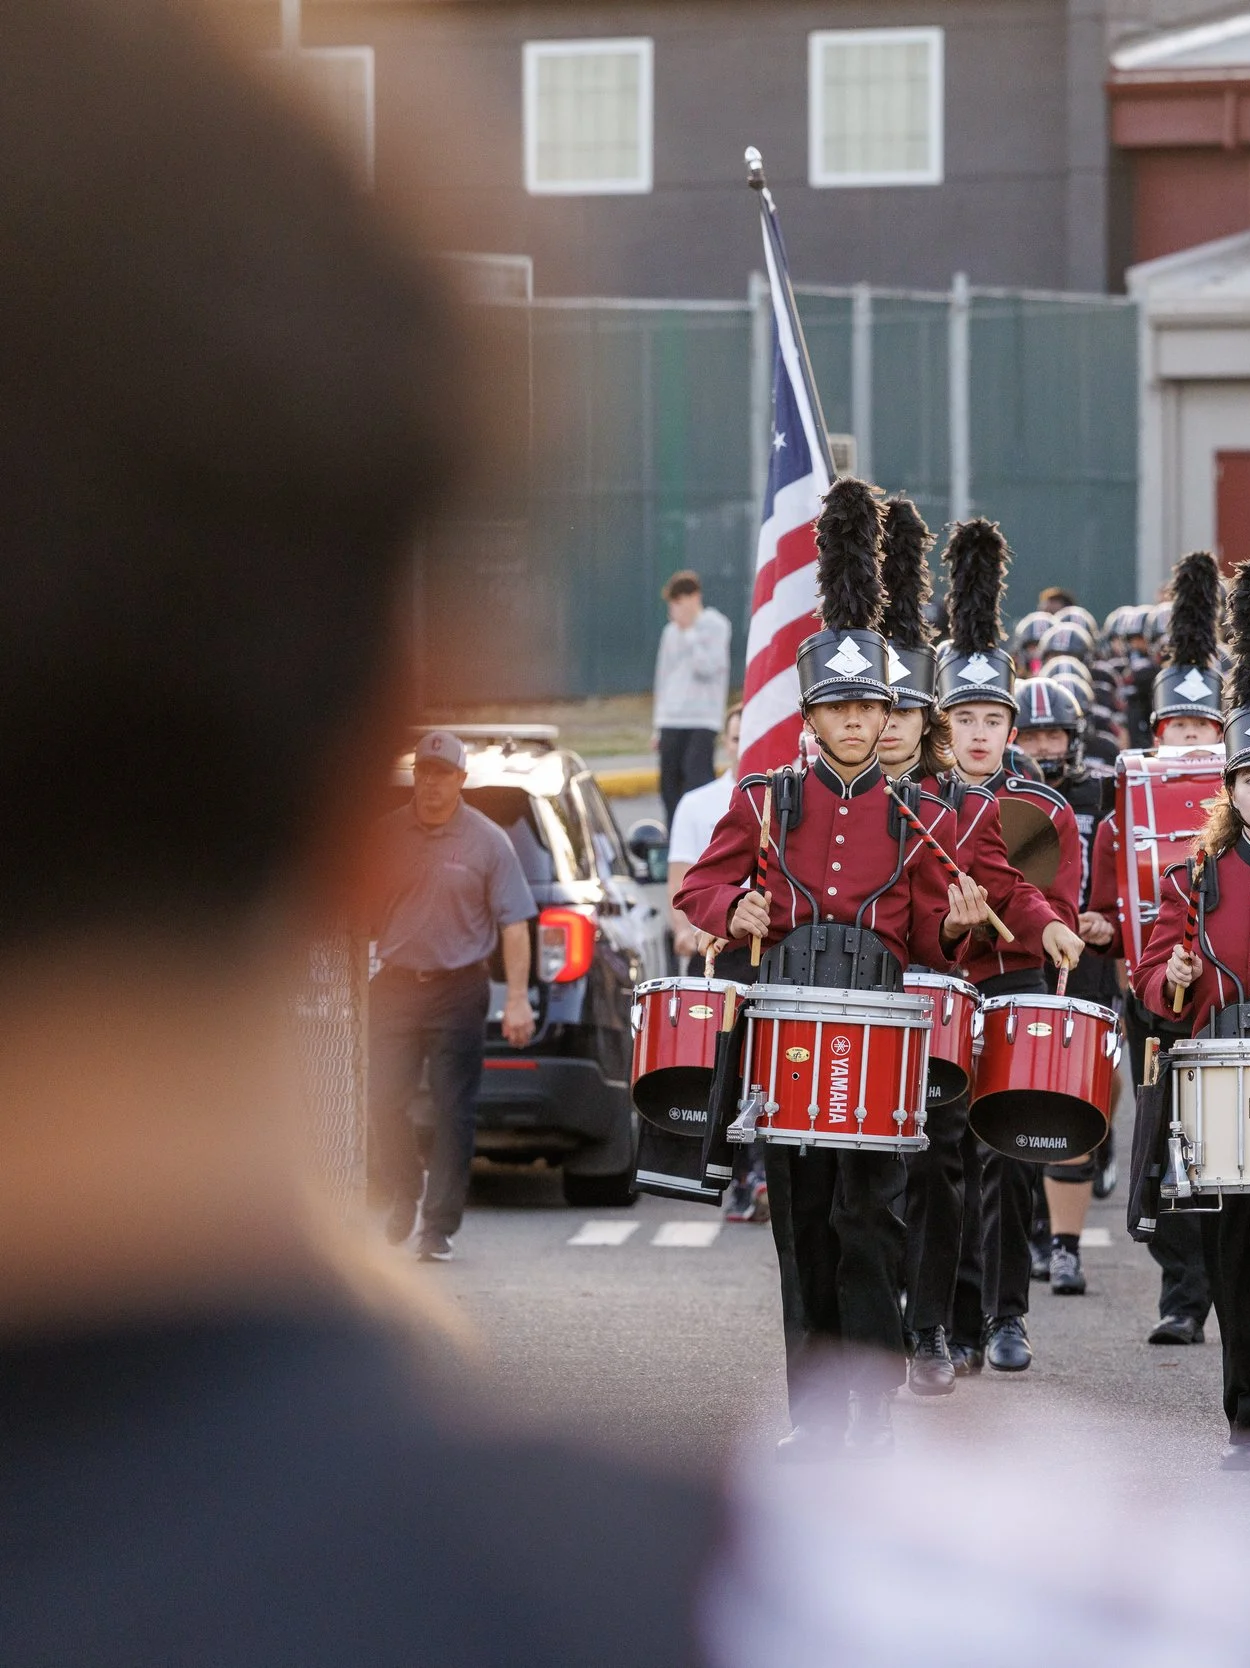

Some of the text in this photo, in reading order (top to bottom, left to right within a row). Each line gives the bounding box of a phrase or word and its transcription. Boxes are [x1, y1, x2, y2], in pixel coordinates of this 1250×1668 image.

[829, 1057, 849, 1124] YAMAHA
[681, 1109, 708, 1122] YAMA
[1028, 1136, 1068, 1149] YAMAHA
